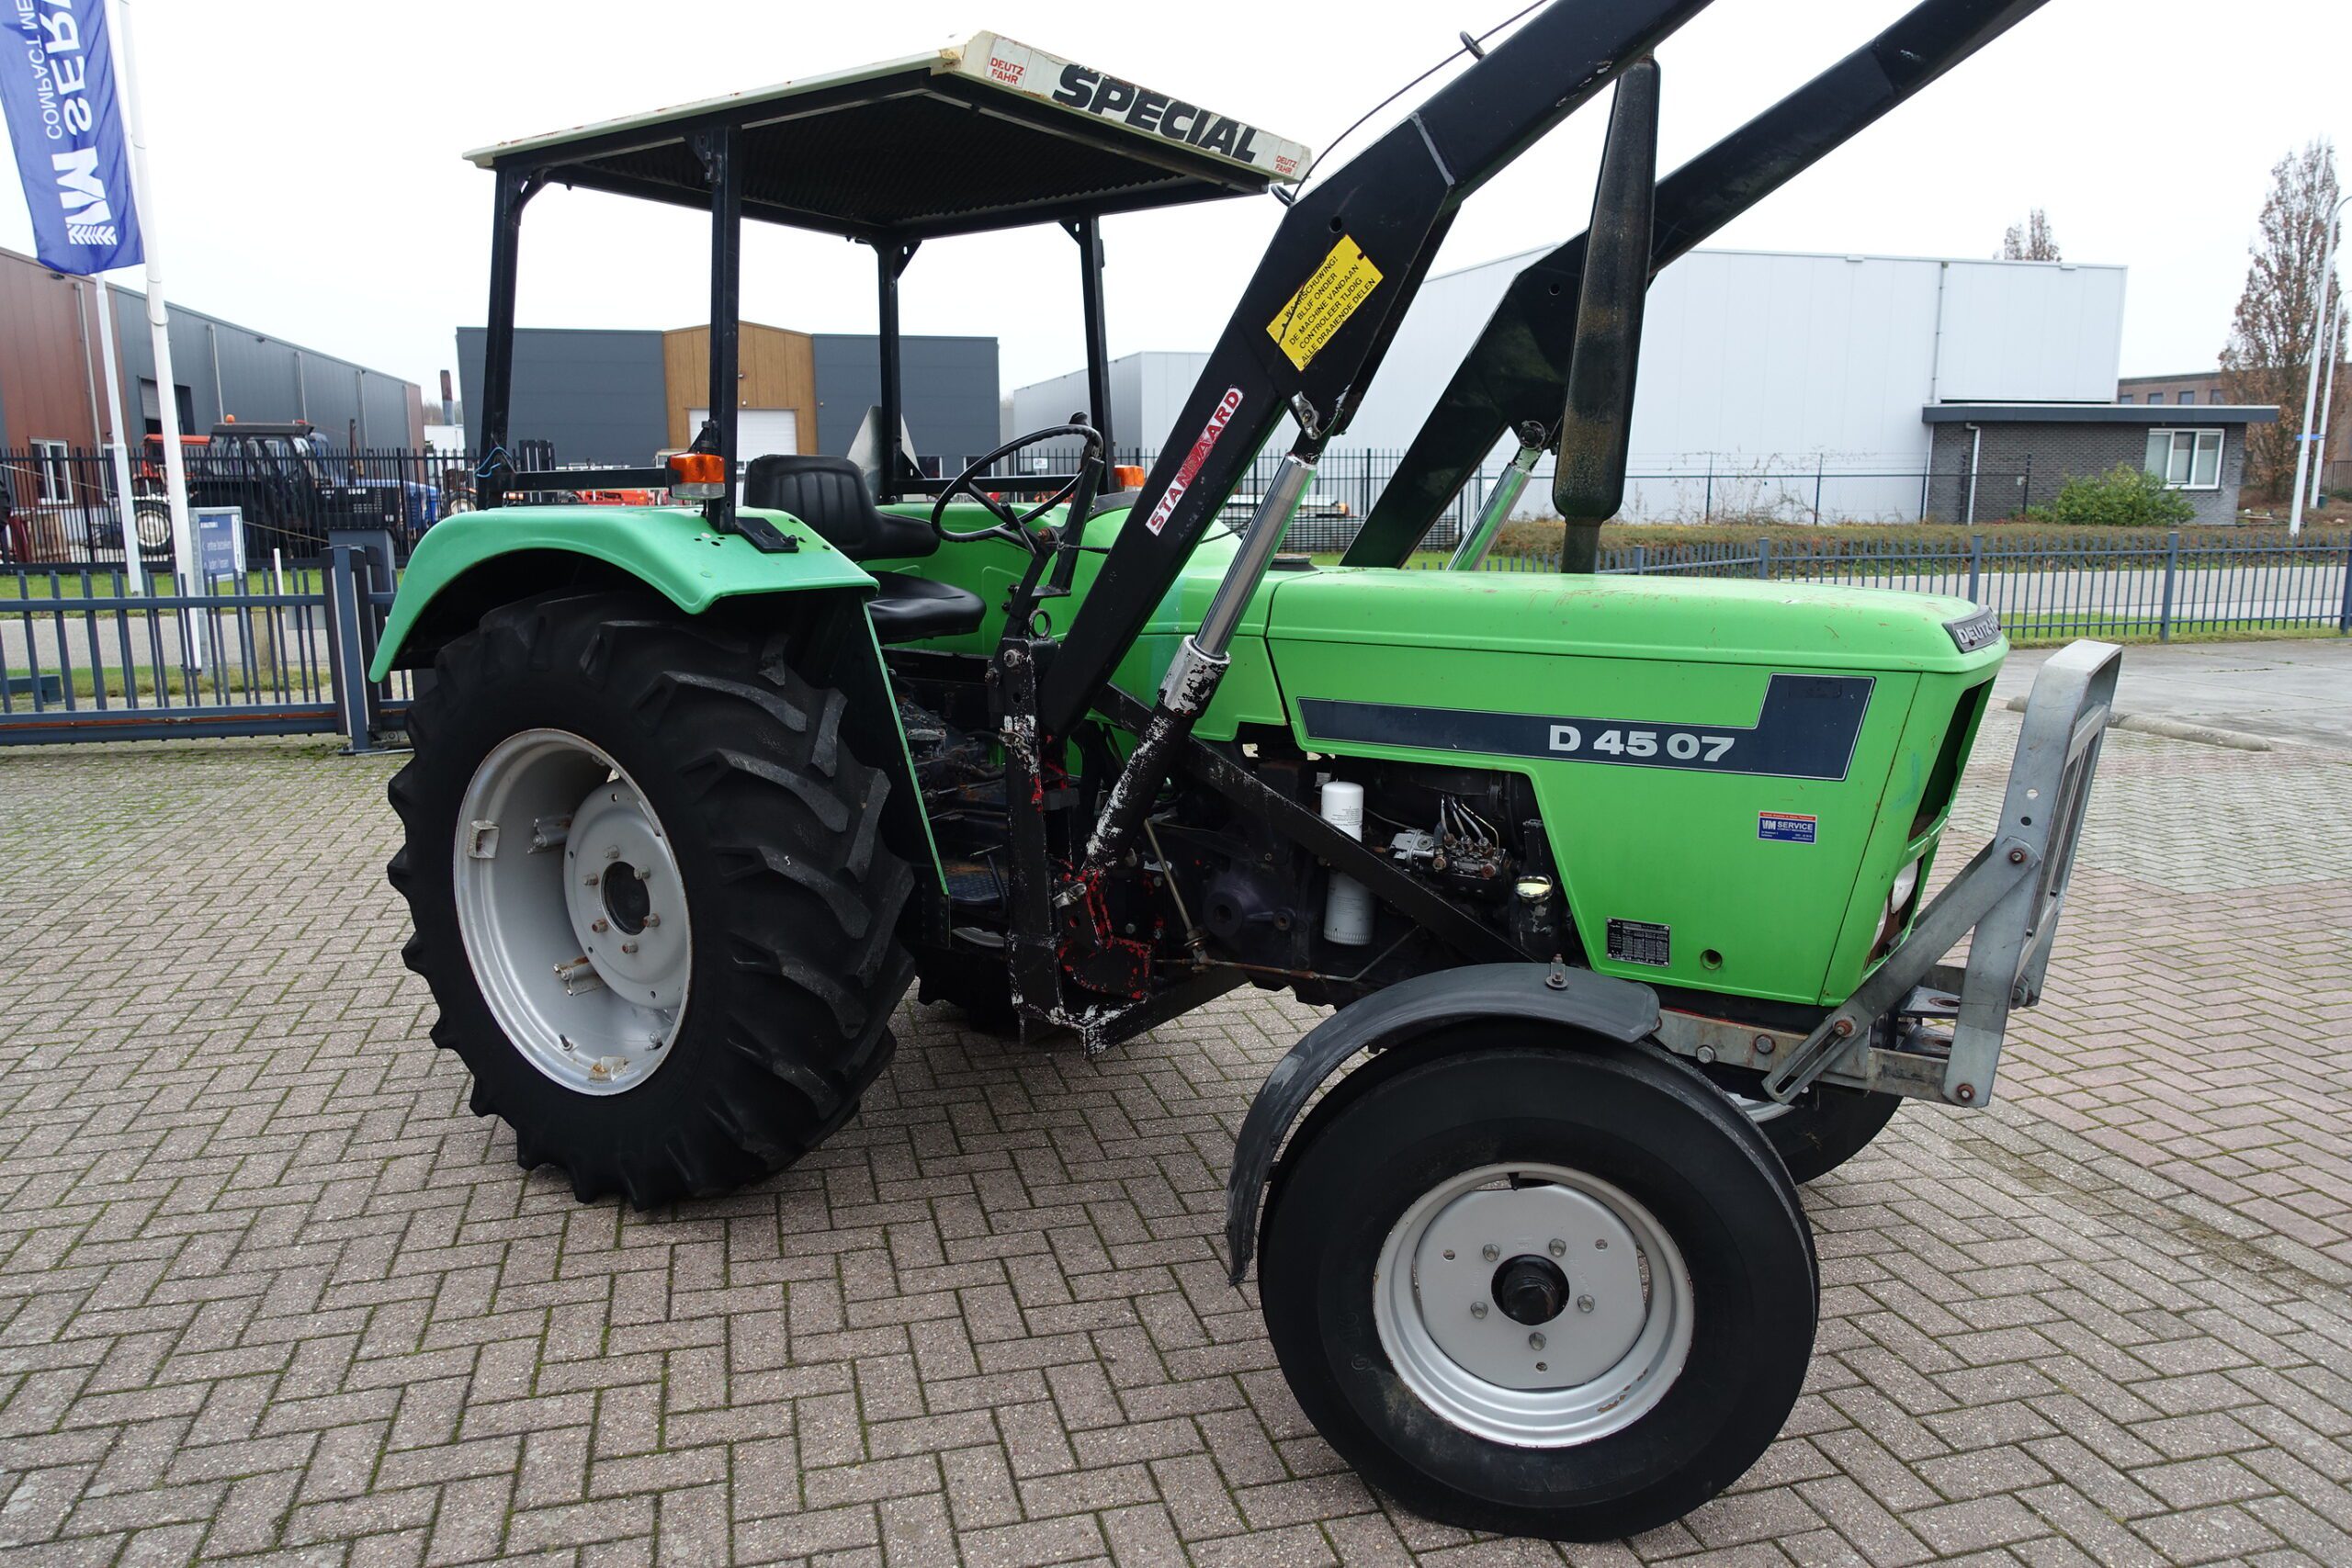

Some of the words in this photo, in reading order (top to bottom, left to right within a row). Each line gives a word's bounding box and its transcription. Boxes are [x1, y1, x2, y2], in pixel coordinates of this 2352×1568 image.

[990, 57, 1024, 76] DEUTZ
[991, 68, 1019, 85] FAHR
[1052, 63, 1261, 164] SPECIAL
[1274, 163, 1293, 175] FAHR
[1275, 154, 1297, 168] DEUTZ
[1289, 333, 1300, 345] DE
[1298, 299, 1329, 333] MACHINE
[1327, 265, 1359, 301] VANDAAN
[1296, 299, 1314, 321] BLIJF
[1314, 272, 1338, 300] ONDER
[1299, 300, 1341, 349] CONTROLEER
[1340, 277, 1363, 301] TIJDIG
[1301, 344, 1318, 362] ALLE
[1317, 303, 1353, 344] DRAAIENDE
[1352, 277, 1376, 304] DELEN
[1150, 391, 1239, 530] STANDAARD
[1549, 725, 1581, 751] D
[1777, 821, 1814, 830] SERVICE
